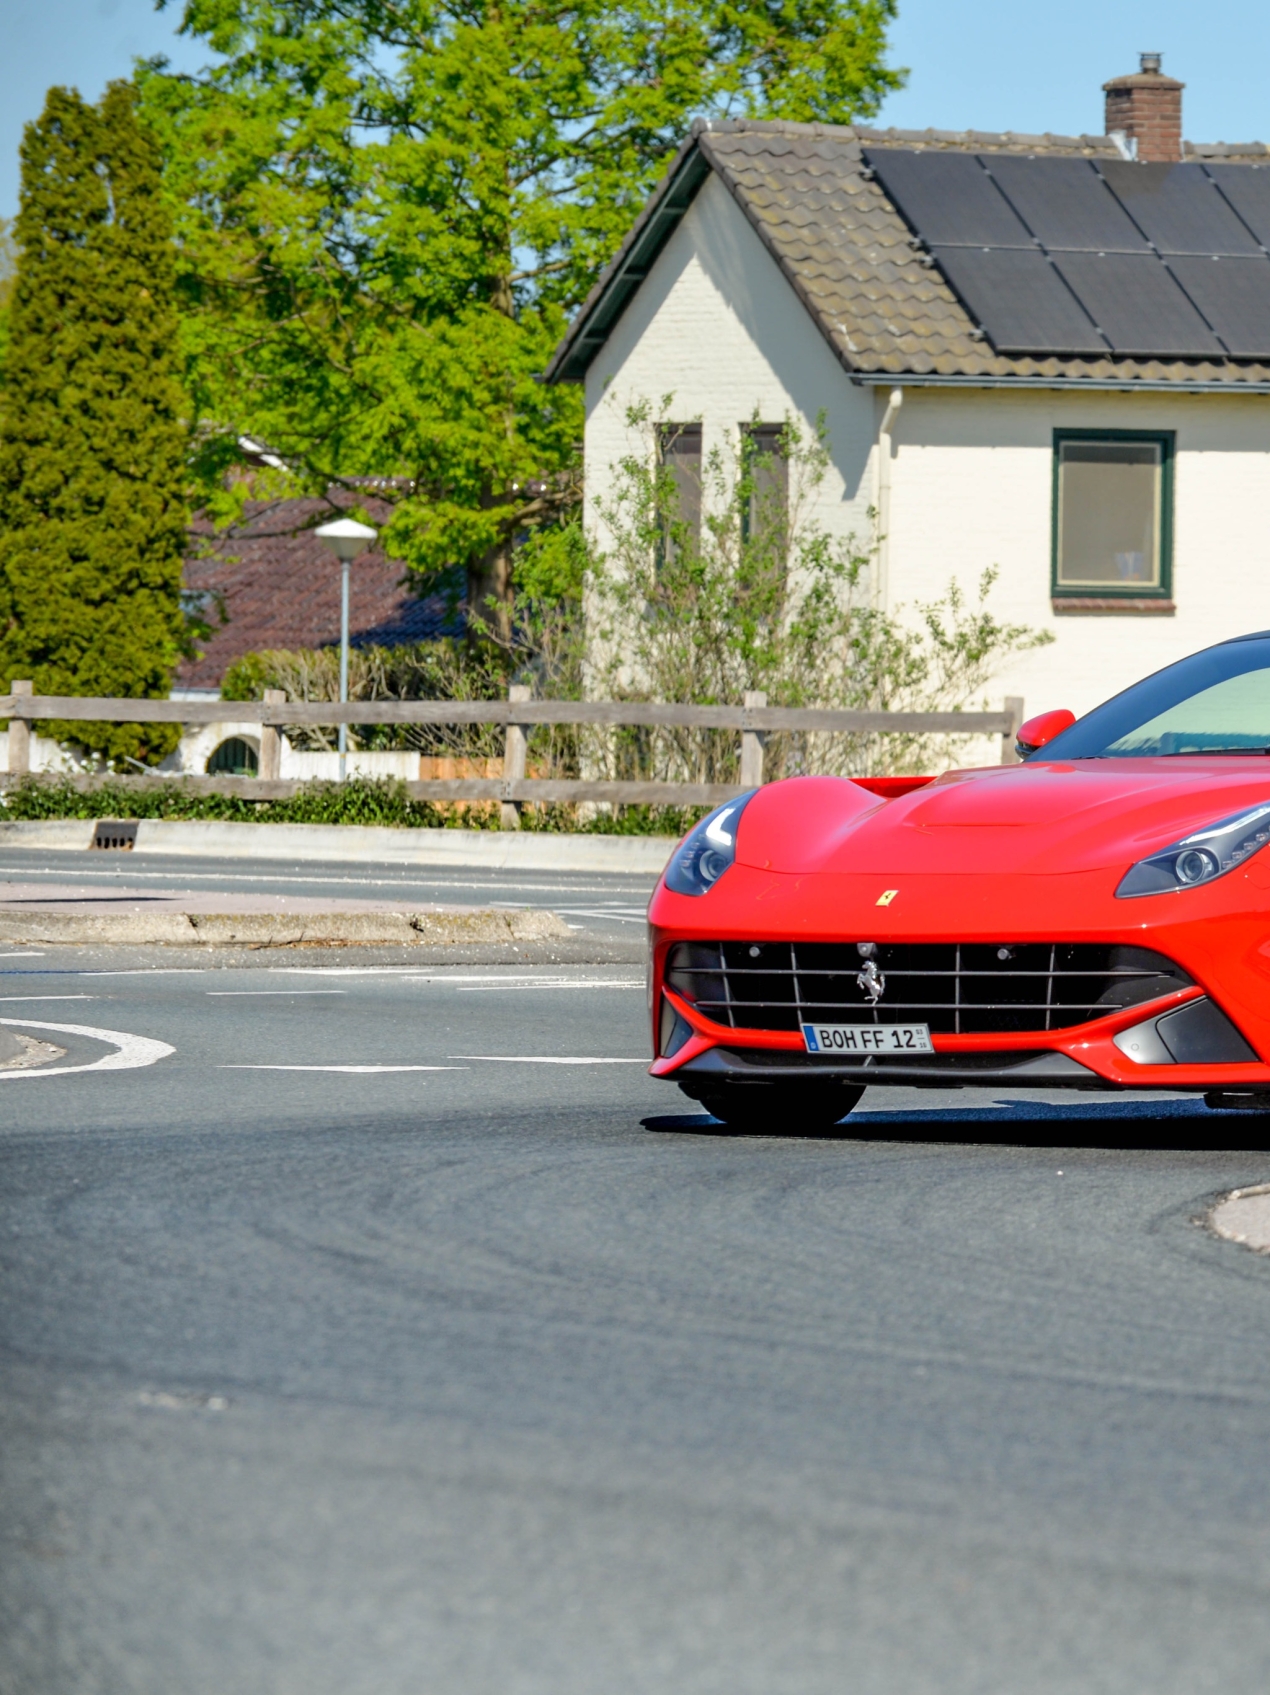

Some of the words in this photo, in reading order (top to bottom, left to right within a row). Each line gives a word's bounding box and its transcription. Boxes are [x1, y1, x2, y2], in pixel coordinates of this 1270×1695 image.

[819, 1030, 858, 1048] BOH
[860, 1030, 884, 1048] FF
[891, 1029, 916, 1048] 12
